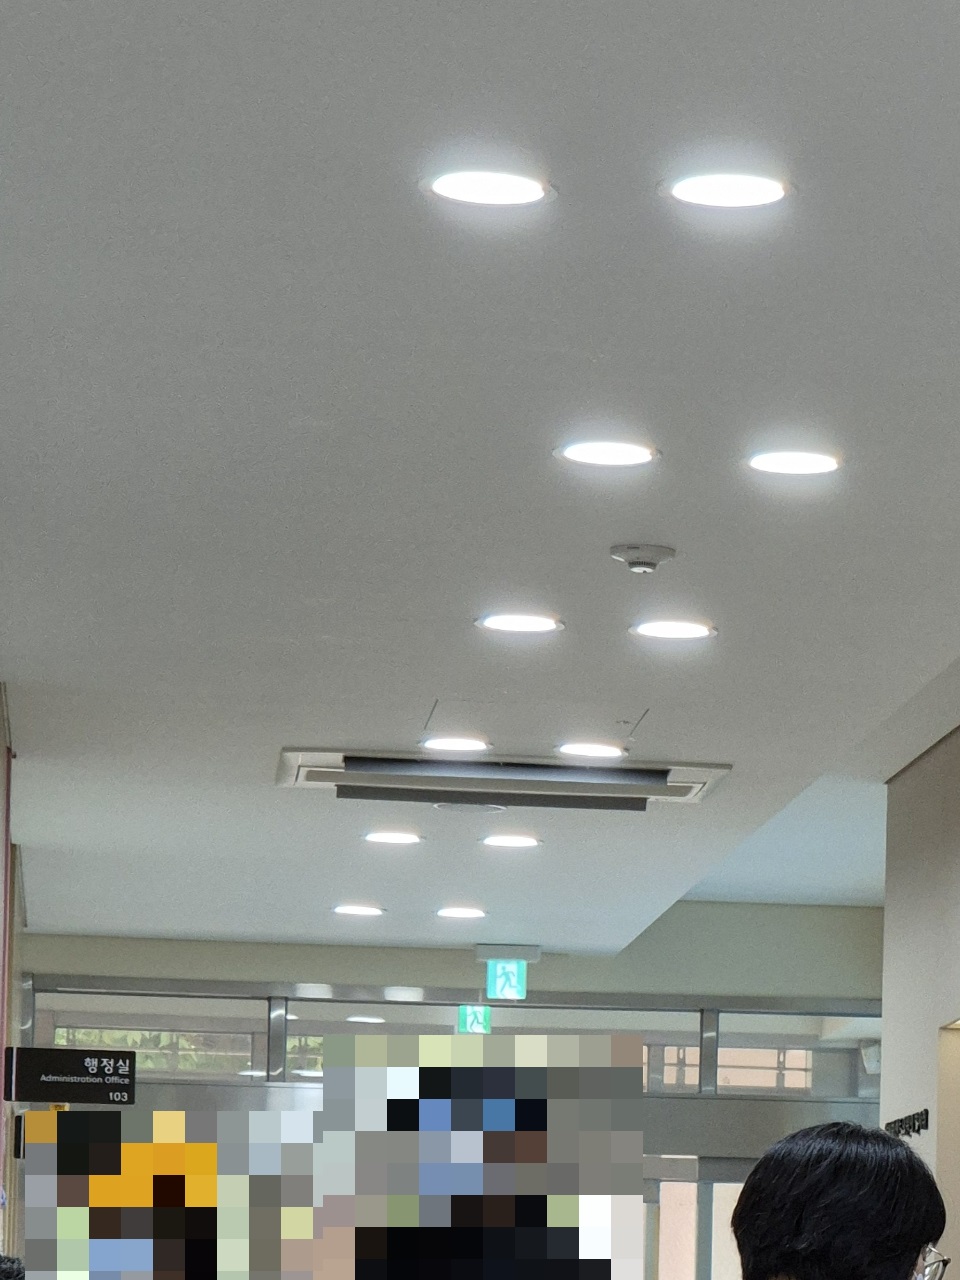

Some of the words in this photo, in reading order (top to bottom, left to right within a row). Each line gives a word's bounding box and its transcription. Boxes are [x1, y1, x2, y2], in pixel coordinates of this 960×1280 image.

[84, 1057, 130, 1074] 행정실
[40, 1073, 103, 1084] Administration
[104, 1075, 130, 1085] Office
[109, 1092, 128, 1102] 103
